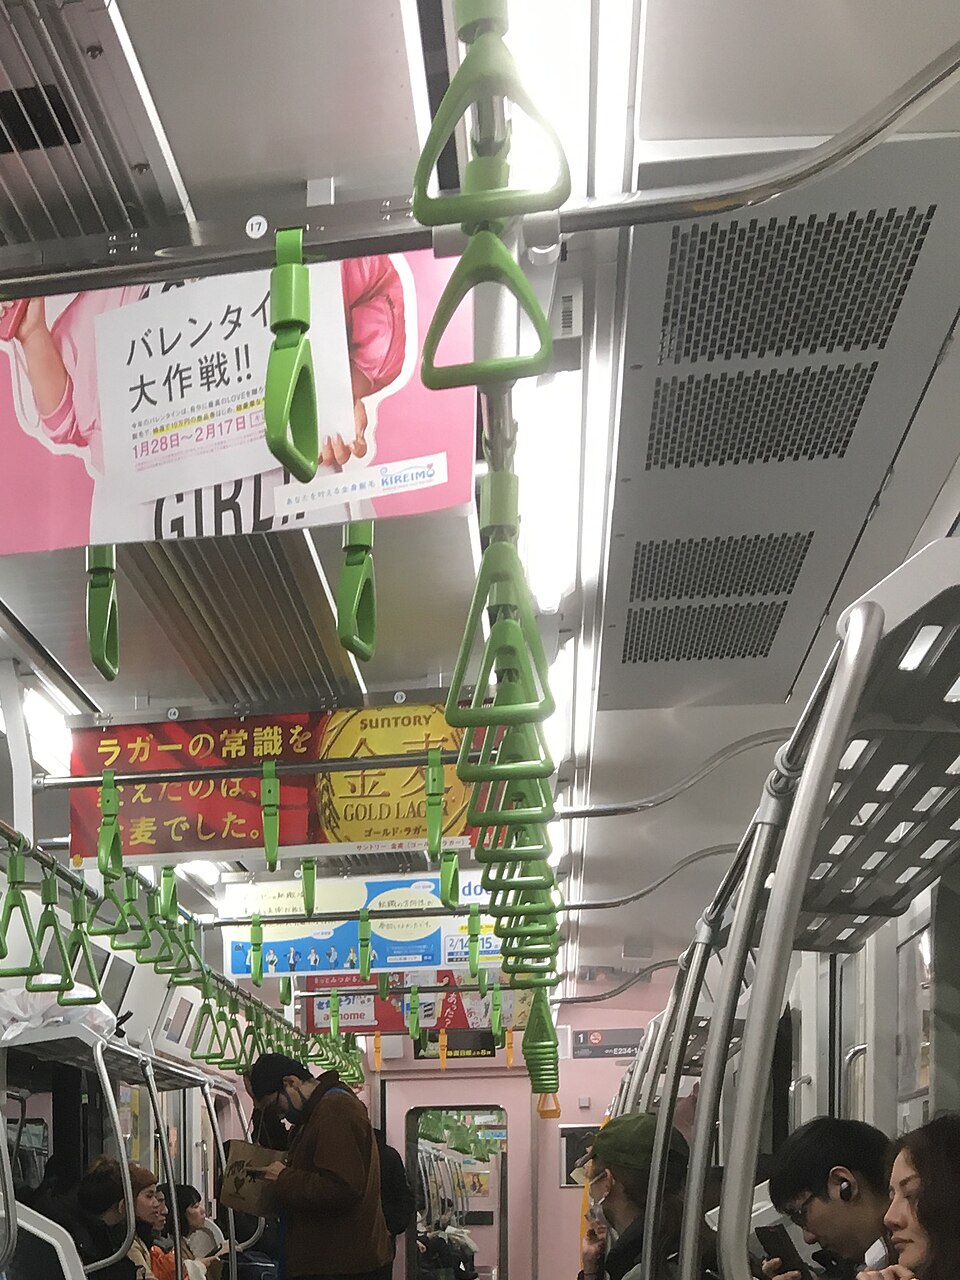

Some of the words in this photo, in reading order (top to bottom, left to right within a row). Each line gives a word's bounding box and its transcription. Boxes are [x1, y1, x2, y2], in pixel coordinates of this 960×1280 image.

[250, 221, 262, 233] 17
[129, 344, 252, 413] 大作戦!!
[359, 713, 434, 731] SUNTORY
[97, 724, 312, 767] ラガーの常識を
[96, 777, 258, 807] えたのは、
[343, 801, 391, 822] GOLD
[395, 799, 450, 820] LAGR
[96, 810, 260, 847] 麦でした。
[578, 1033, 584, 1043] 1
